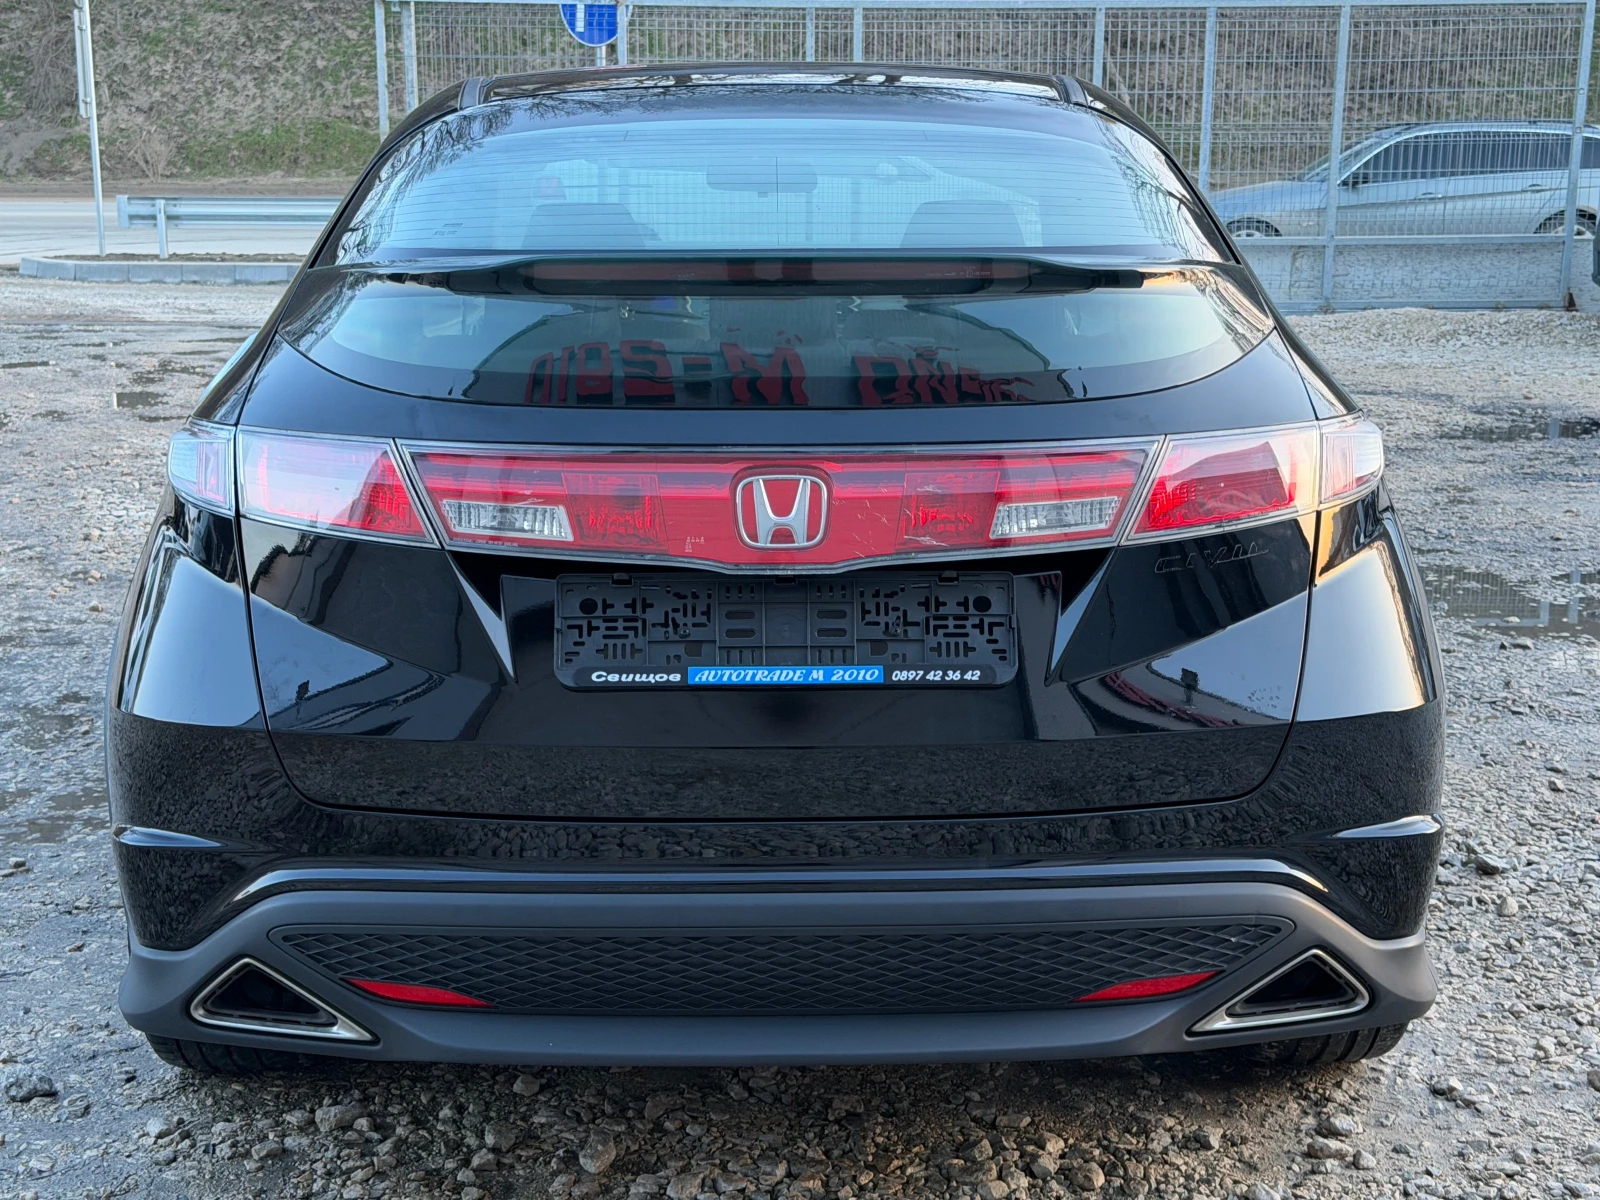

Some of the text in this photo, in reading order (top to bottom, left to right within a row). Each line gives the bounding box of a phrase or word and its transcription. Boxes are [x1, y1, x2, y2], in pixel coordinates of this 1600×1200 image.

[591, 671, 682, 684] Свищов
[694, 668, 879, 682] AUTOTRADE M 2010
[891, 670, 981, 681] 0897 42 36 42
